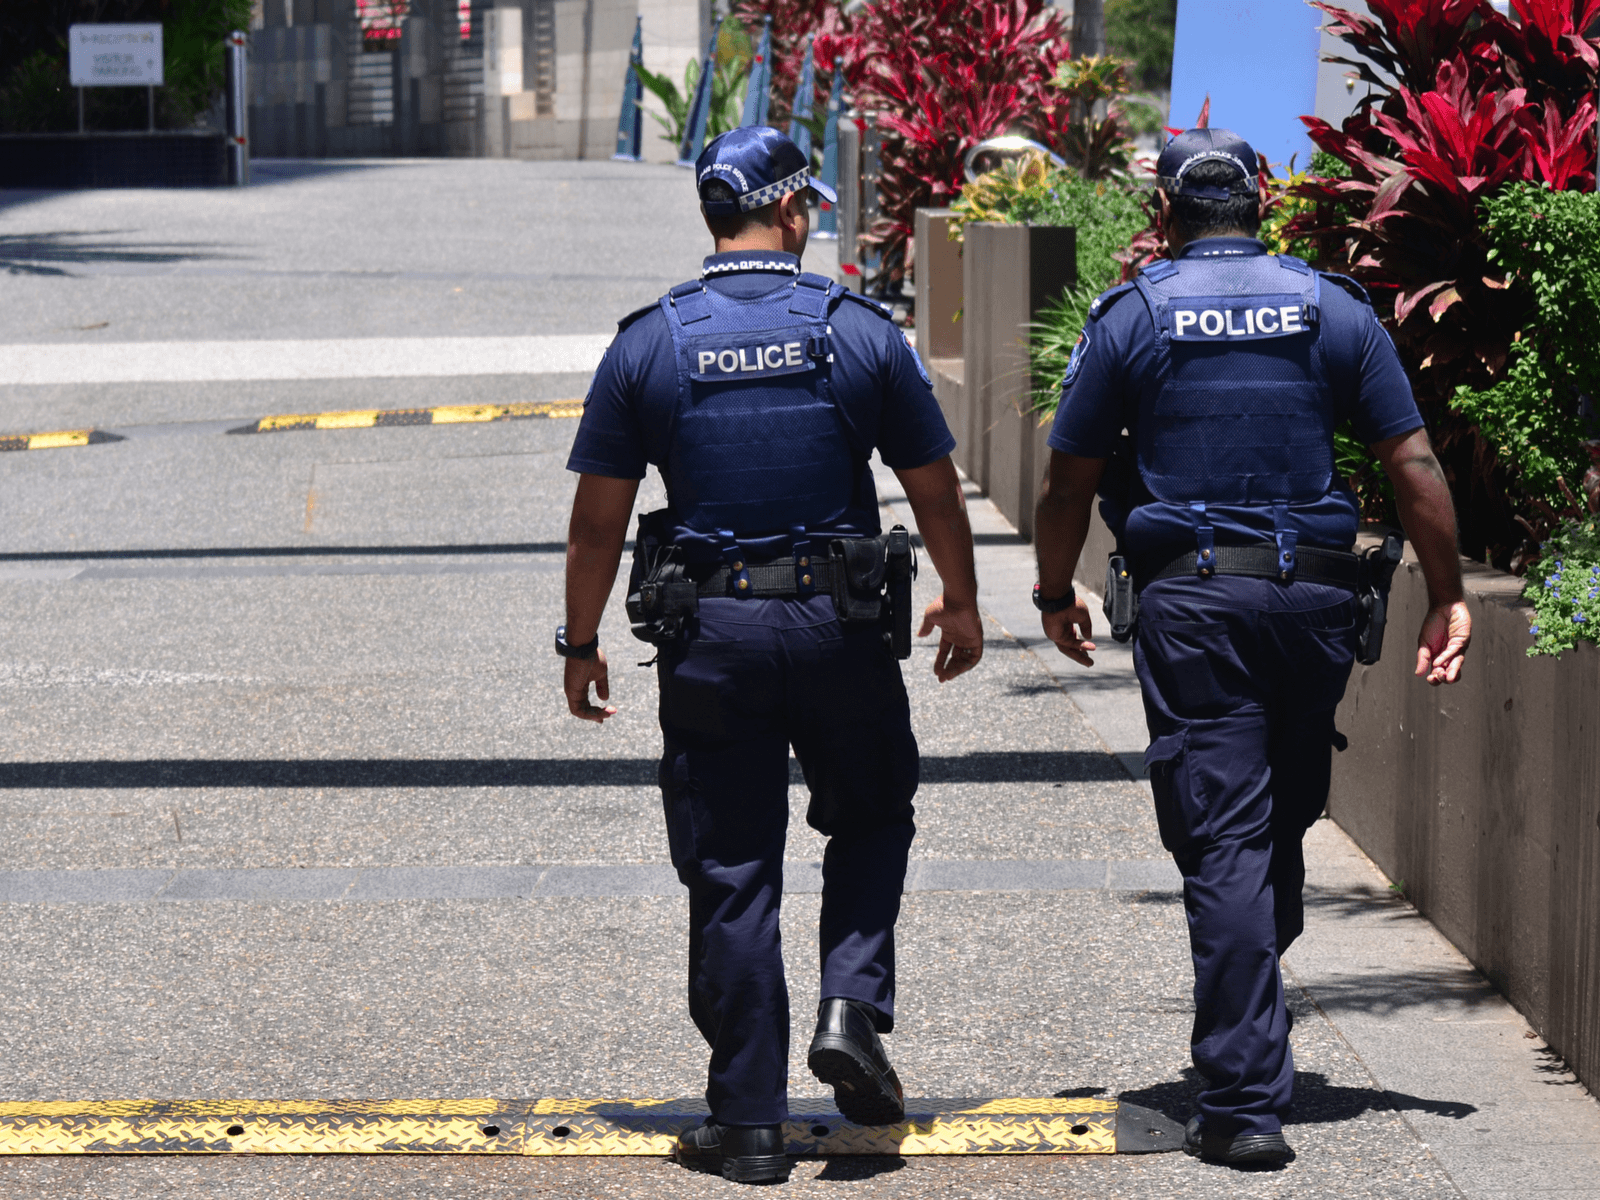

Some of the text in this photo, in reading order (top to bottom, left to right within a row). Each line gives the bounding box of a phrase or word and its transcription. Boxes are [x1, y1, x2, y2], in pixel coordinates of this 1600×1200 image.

[1209, 150, 1232, 160] POLICE
[712, 163, 749, 193] POLICE SERVICE
[740, 260, 764, 270] QPS
[1175, 306, 1302, 336] POLICE
[698, 342, 803, 374] POLICE
